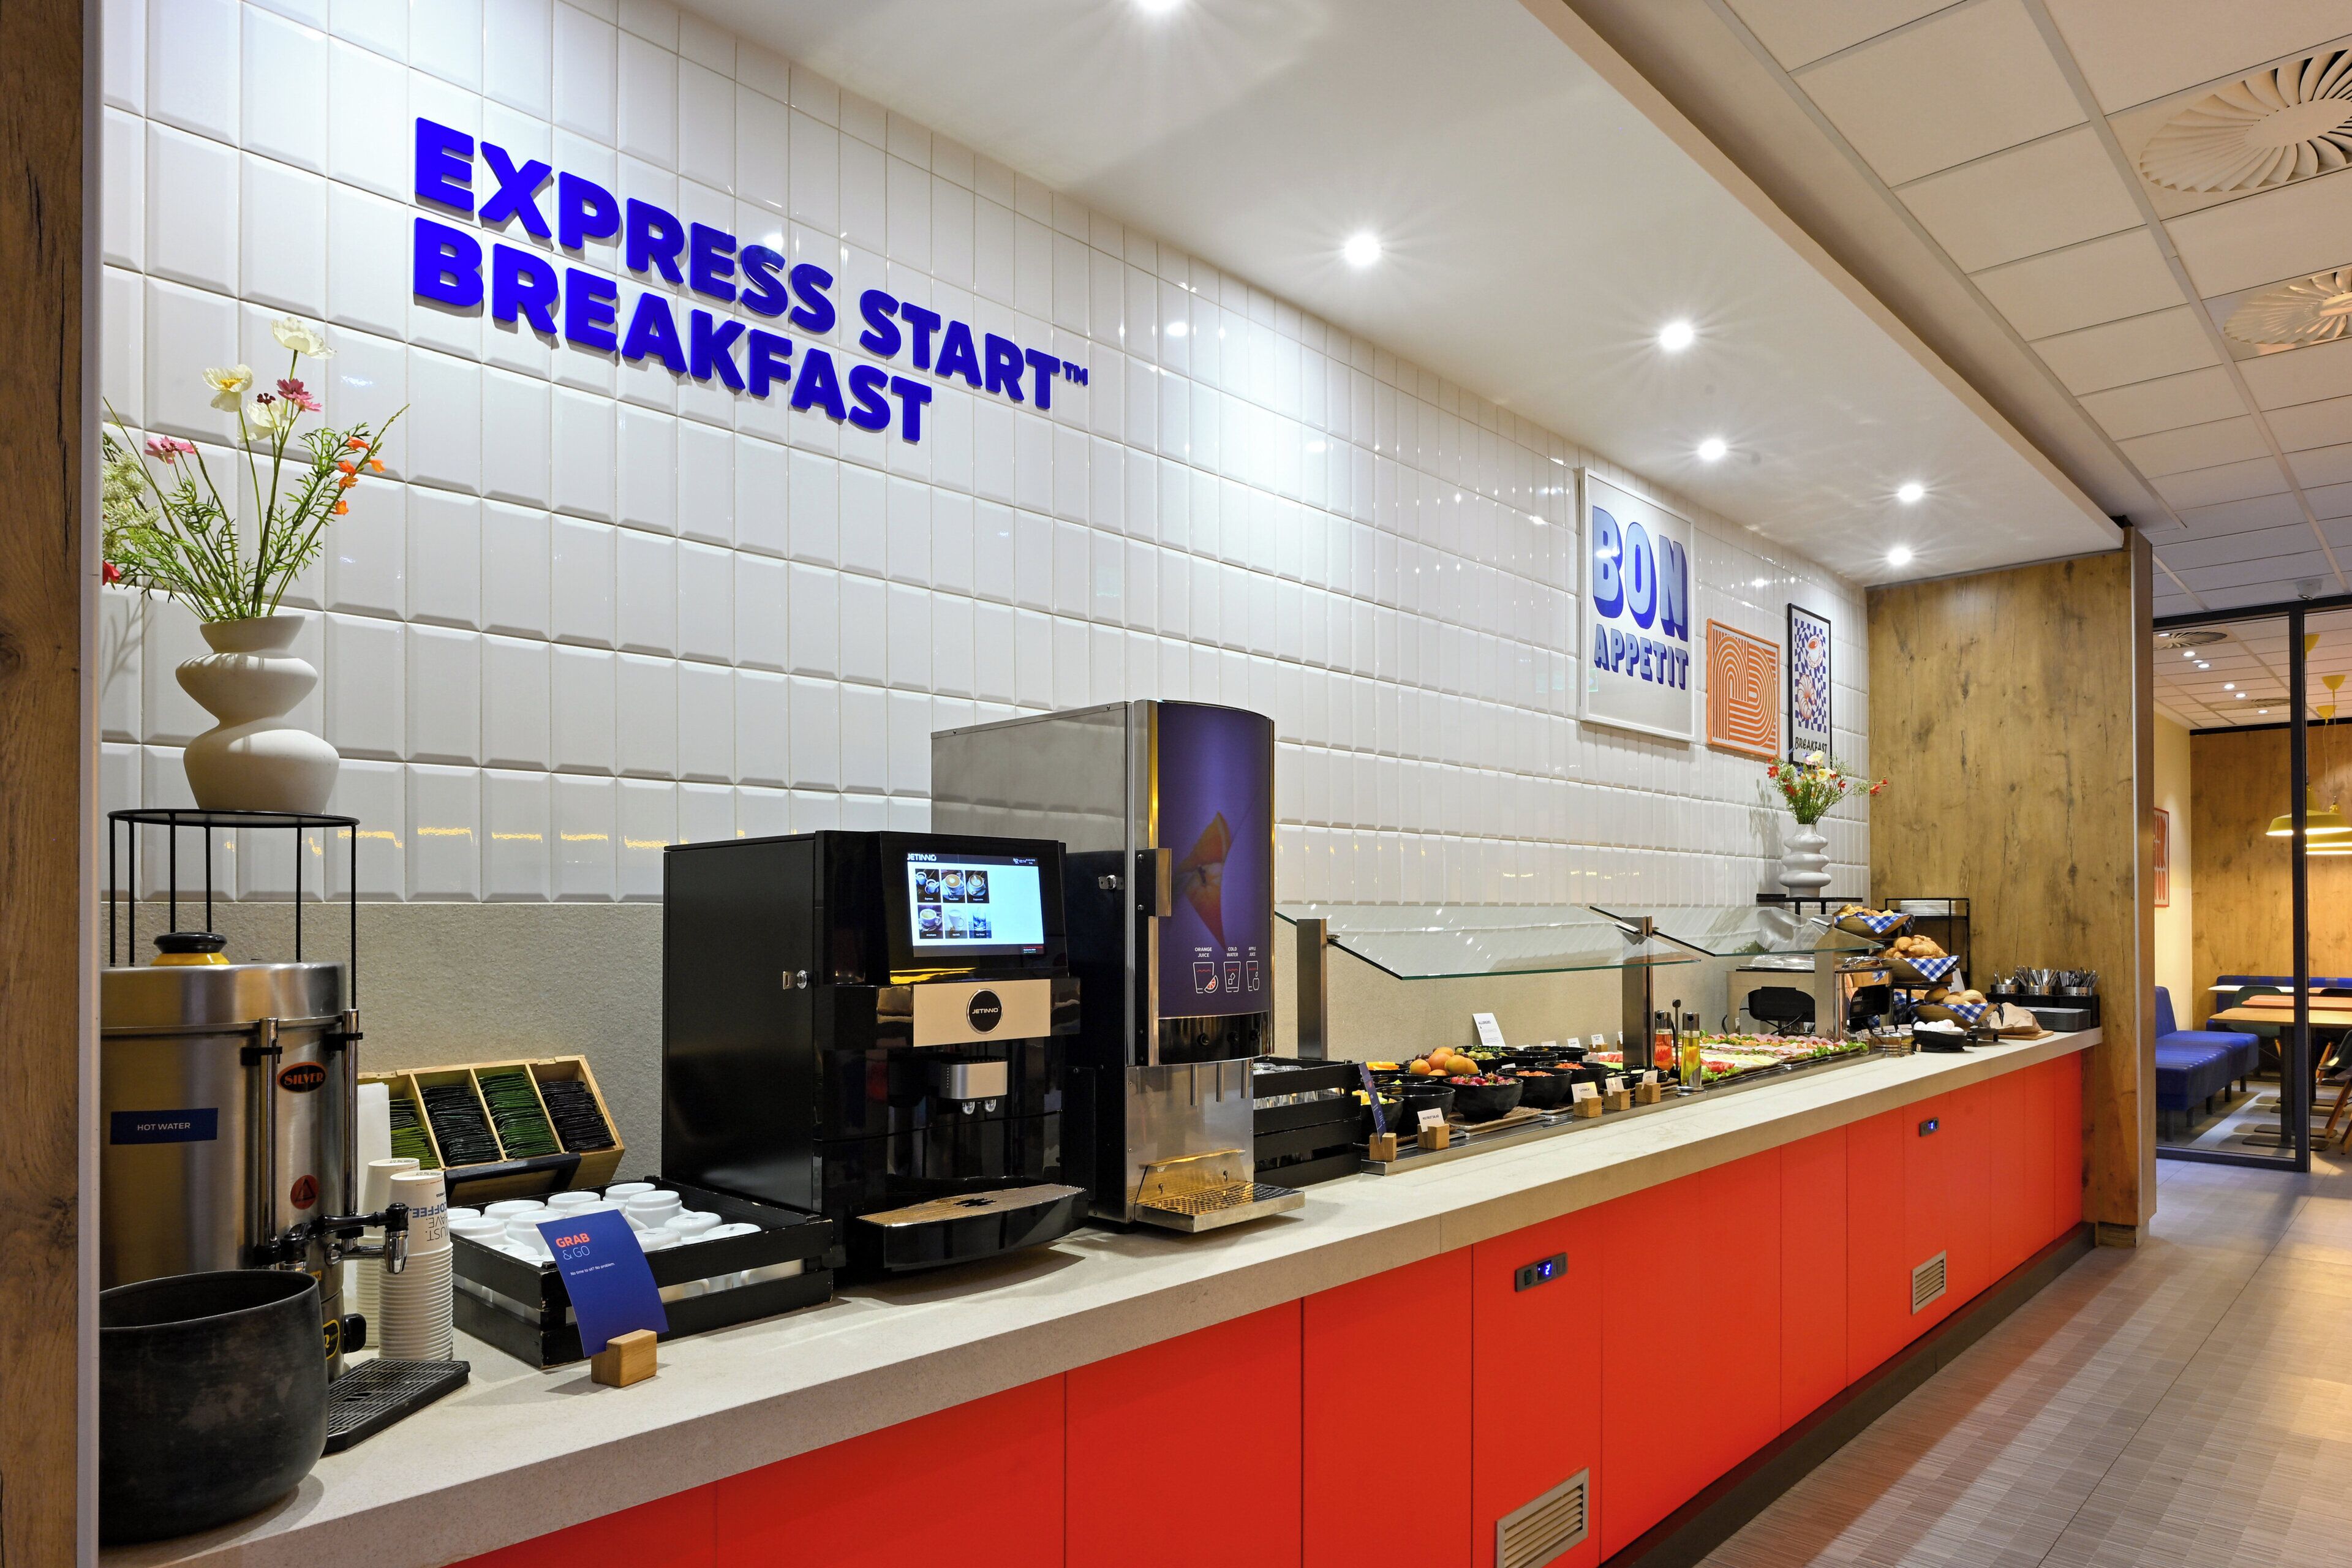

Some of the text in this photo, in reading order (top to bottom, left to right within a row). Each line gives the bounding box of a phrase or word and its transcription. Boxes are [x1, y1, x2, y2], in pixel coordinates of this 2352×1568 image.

[414, 117, 835, 333] EXPRESS
[413, 217, 932, 442] BREAKFAST
[1593, 505, 1688, 642] BON
[1594, 624, 1689, 690] APPETIT
[1795, 737, 1827, 754] BREAKFAST
[284, 1072, 323, 1085] SILVER
[556, 1233, 590, 1248] GRAB
[563, 1246, 590, 1260] & GO
